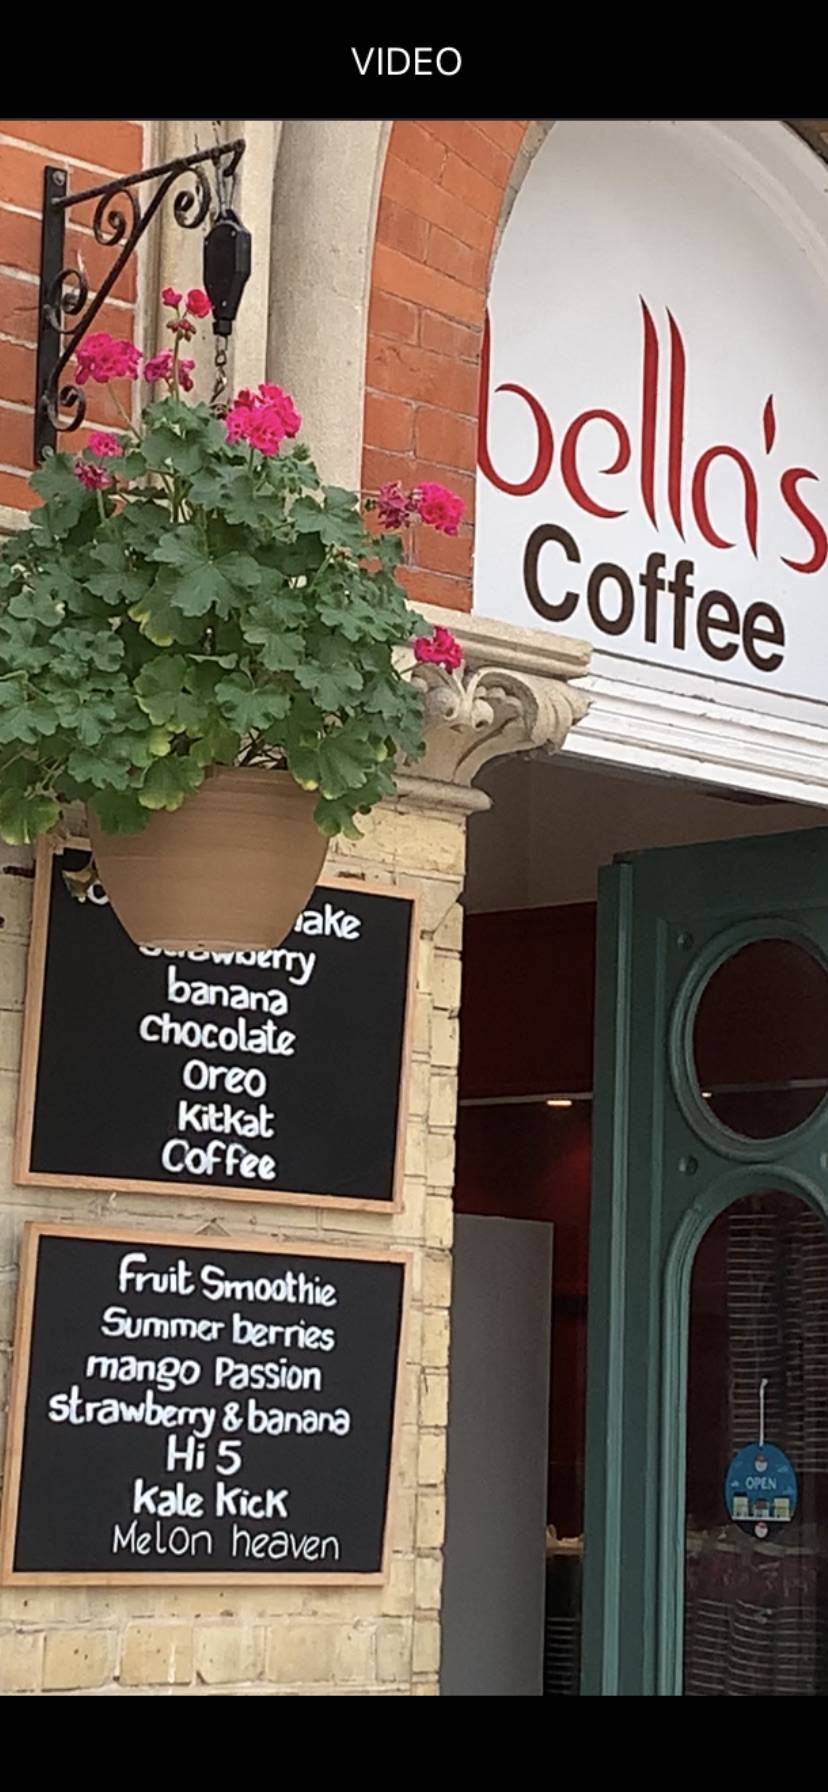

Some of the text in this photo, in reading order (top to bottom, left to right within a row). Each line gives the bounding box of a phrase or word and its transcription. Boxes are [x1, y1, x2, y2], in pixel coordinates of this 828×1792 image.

[477, 294, 828, 574] bella's
[523, 522, 786, 673] Coffee
[167, 964, 289, 1017] banana
[182, 1059, 267, 1098] Oreo
[160, 1138, 277, 1182] Coffee
[200, 1264, 338, 1308] Smoothie
[100, 1305, 336, 1352] Summer berries
[85, 1355, 322, 1392] mango Passion
[222, 1402, 244, 1432] &
[248, 1398, 351, 1436] banana
[166, 1433, 243, 1476] Hi 5
[745, 1475, 777, 1490] OPEN
[112, 1520, 341, 1562] Melon heaven
